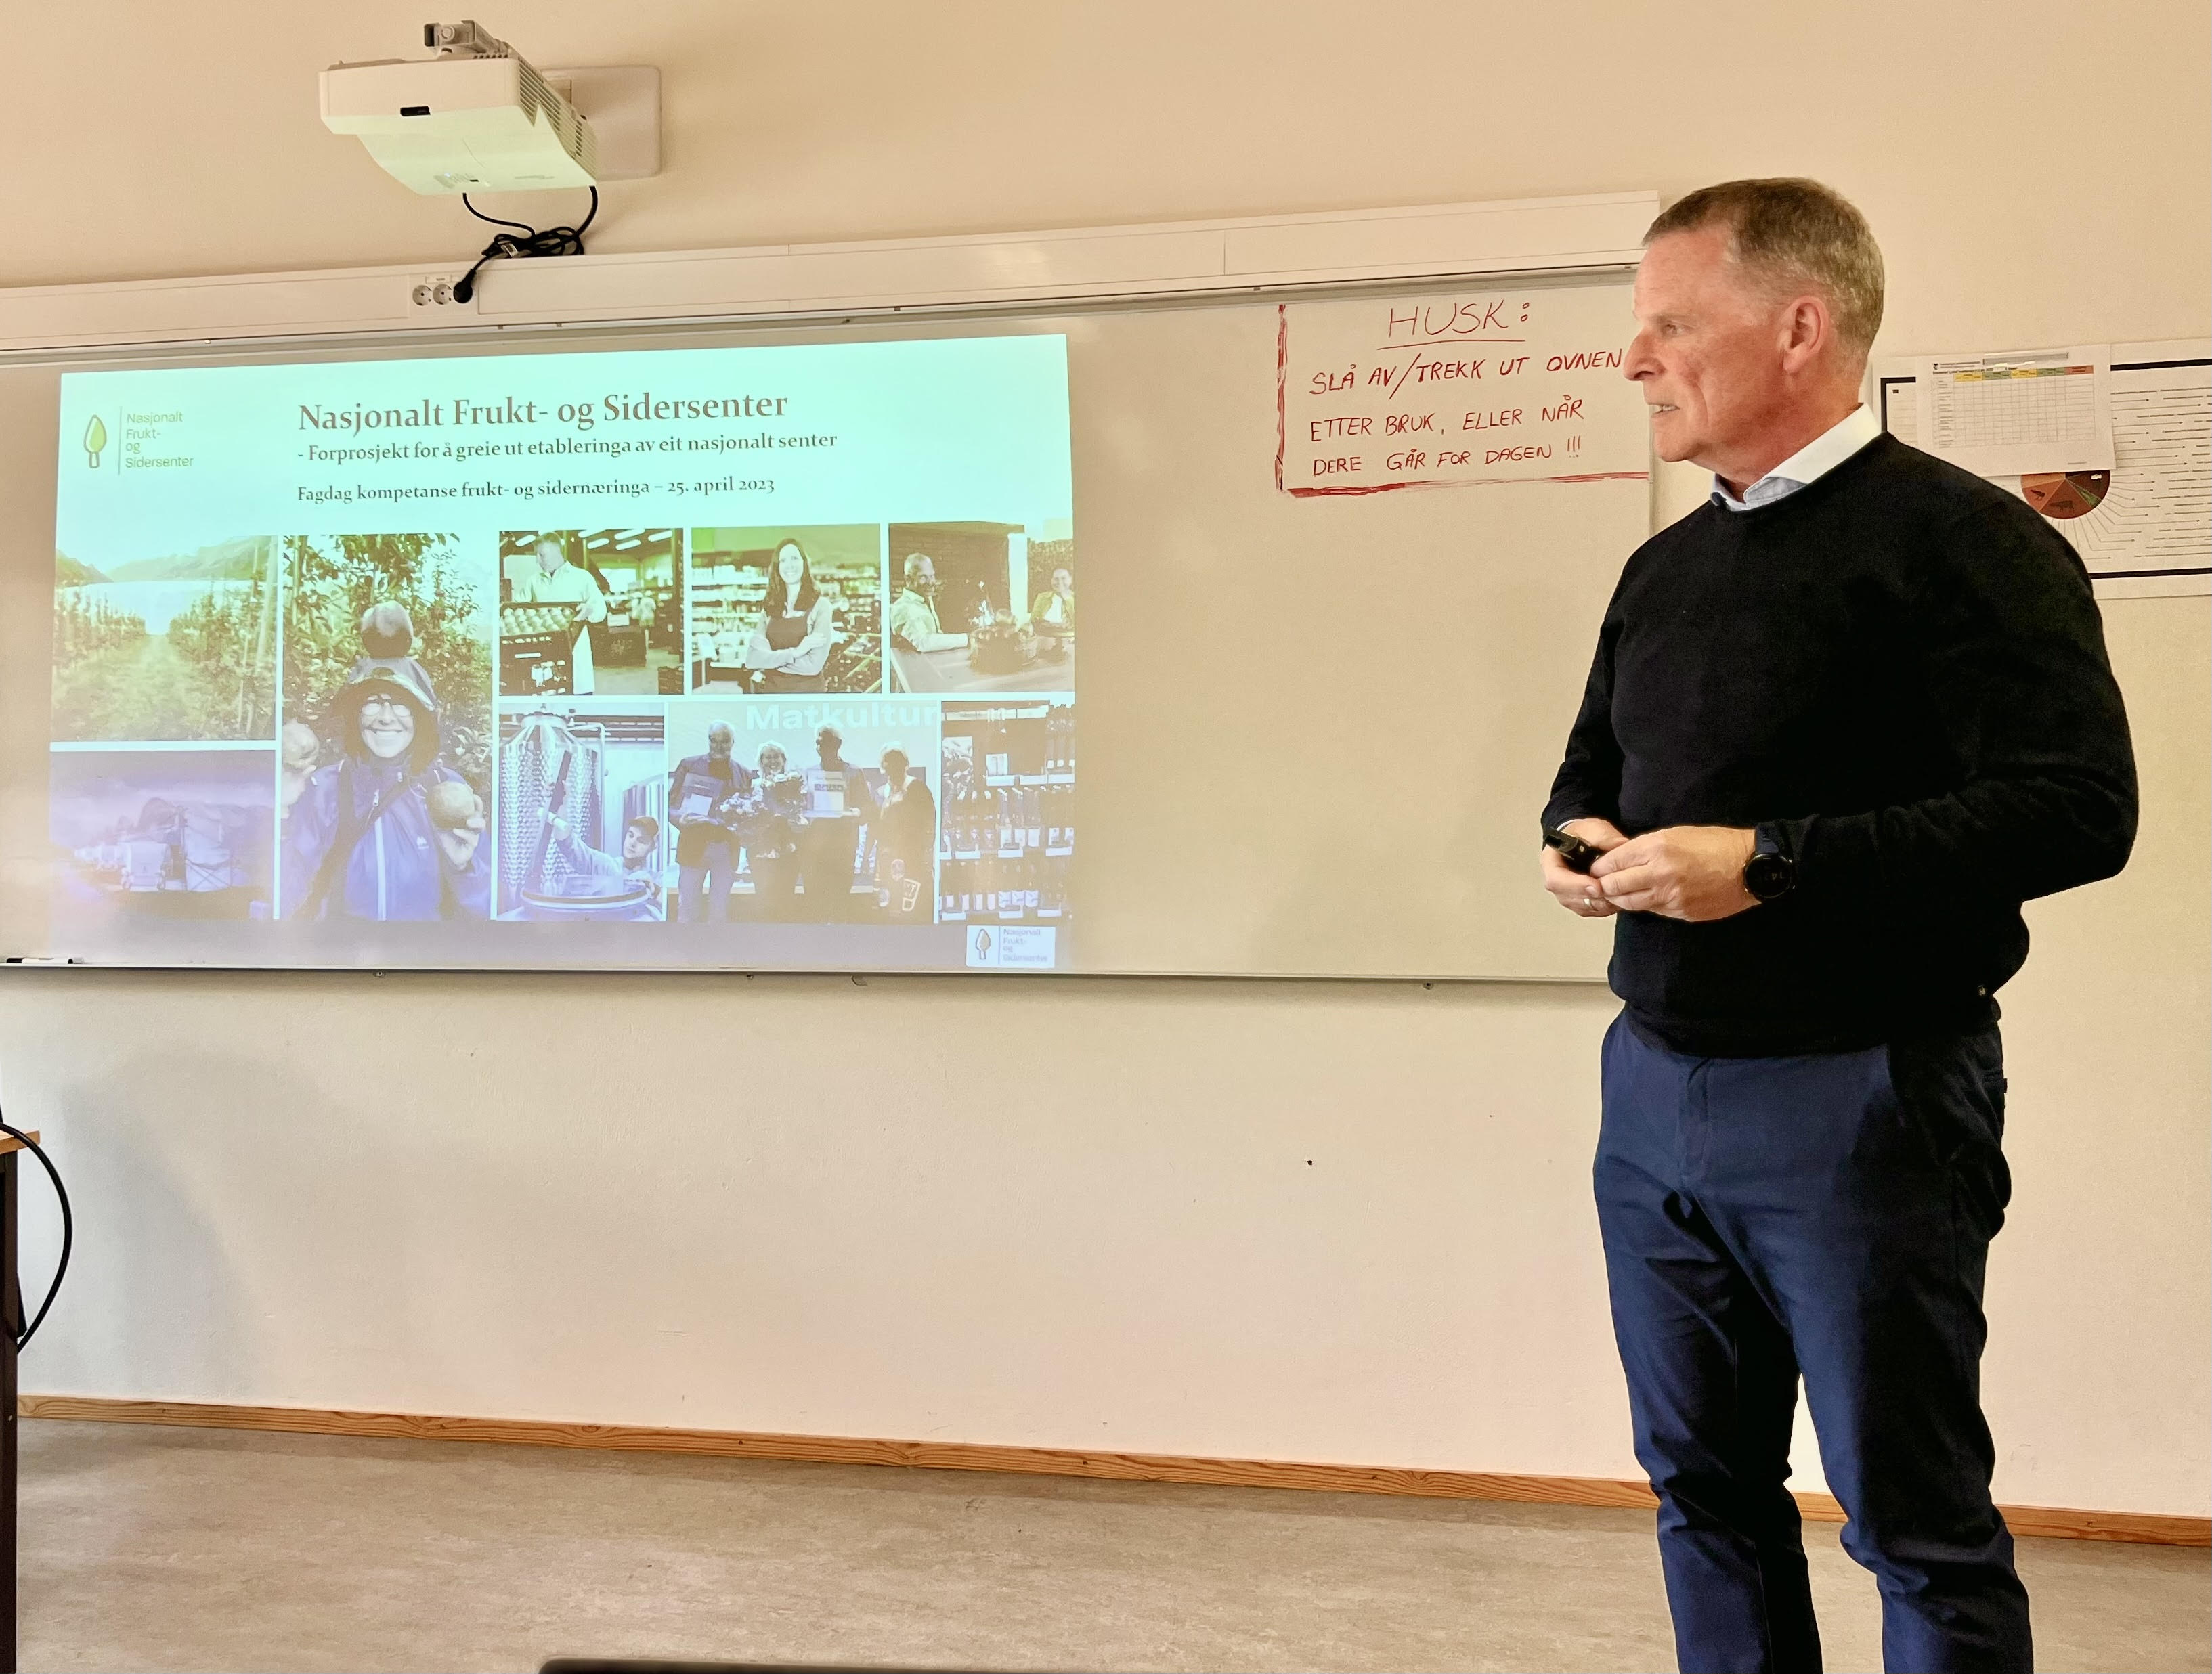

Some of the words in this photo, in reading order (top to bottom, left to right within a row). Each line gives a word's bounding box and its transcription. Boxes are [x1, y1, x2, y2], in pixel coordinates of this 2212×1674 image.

[1309, 364, 1355, 395] SLÅ
[1499, 356, 1530, 376] UT
[1546, 348, 1622, 372] OVNEN
[127, 412, 183, 425] Nasjonalt
[299, 399, 444, 437] Nasjonalt
[453, 397, 548, 425] Frukt-
[557, 399, 595, 431] og
[603, 392, 788, 422] Sidersenter
[1311, 417, 1373, 442] ETTER
[1385, 412, 1445, 436] BRUK,
[1462, 408, 1523, 431] ELLER
[1541, 395, 1584, 422] NÅR
[127, 428, 161, 439] Frukt-
[309, 442, 410, 464] Forprosjekt
[414, 442, 440, 459] for
[443, 443, 453, 458] å
[455, 441, 502, 462] greie
[505, 442, 524, 456] ut
[528, 437, 632, 458] etableringa
[635, 439, 655, 453] av
[659, 435, 683, 452] eit
[687, 433, 775, 455] nasjonalt
[778, 432, 838, 448] senter
[125, 443, 141, 454] og
[125, 456, 194, 468] Sidersenter
[1313, 456, 1362, 476] DERE
[1387, 449, 1426, 469] GÅR
[1437, 451, 1471, 466] FOR
[1485, 444, 1552, 465] DAGEN
[297, 485, 353, 504] Fagdag
[357, 483, 457, 502] kompetanse
[461, 481, 510, 497] frukt-
[514, 486, 534, 500] og
[538, 479, 649, 498] sidernæringa
[667, 482, 689, 495] 25.
[693, 476, 734, 495] april
[738, 478, 775, 493] 2023
[747, 701, 938, 730] Matkultur
